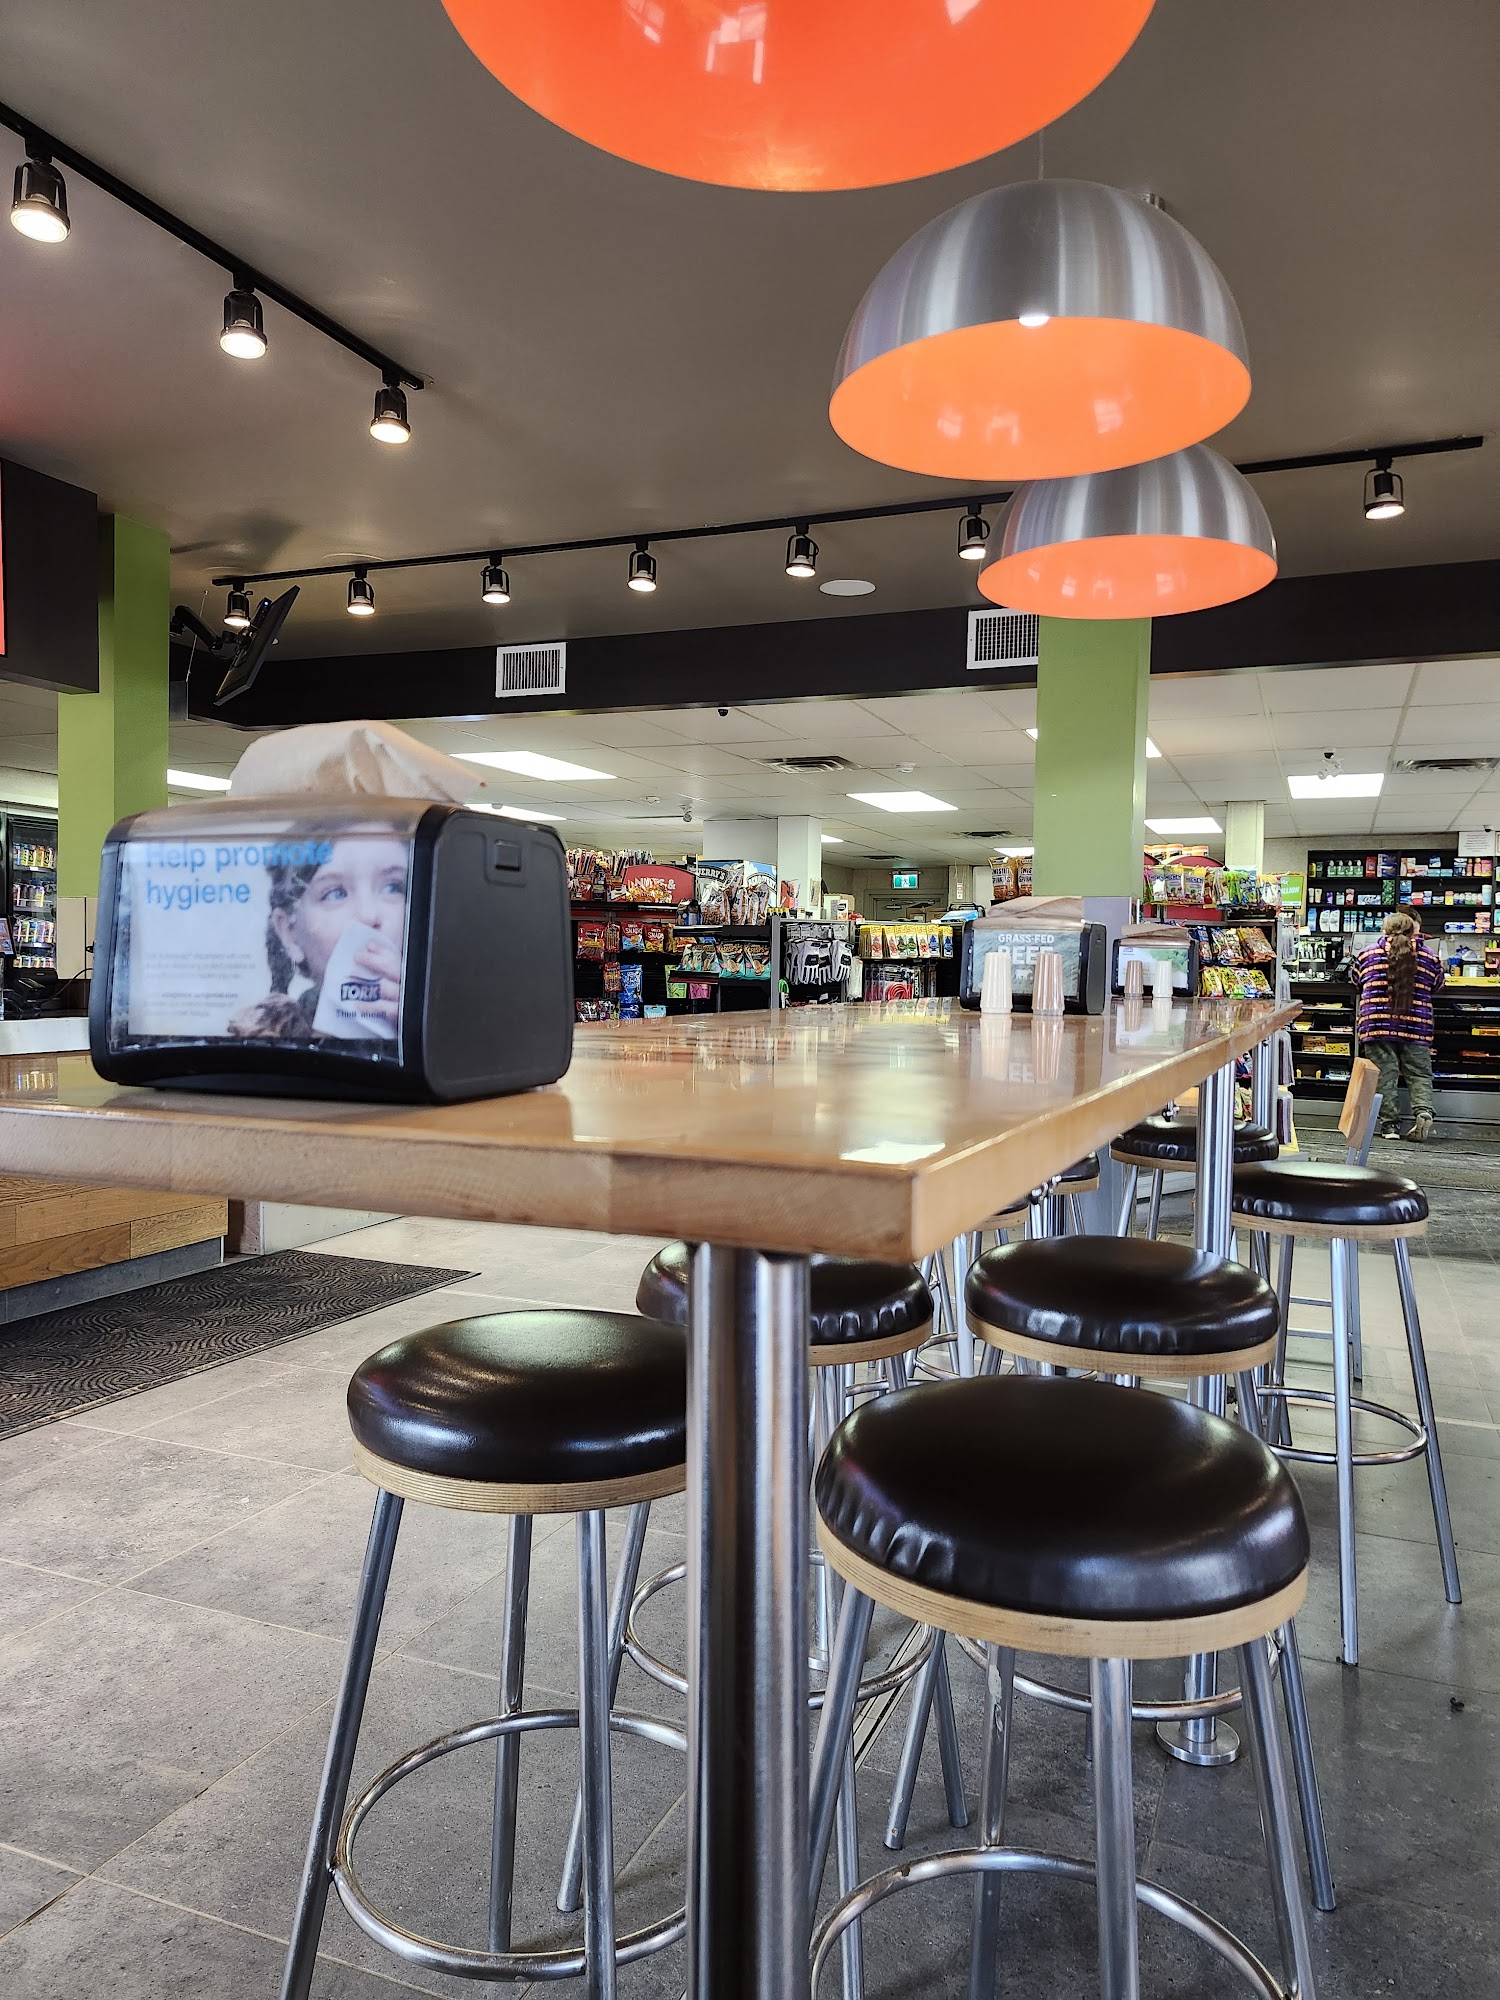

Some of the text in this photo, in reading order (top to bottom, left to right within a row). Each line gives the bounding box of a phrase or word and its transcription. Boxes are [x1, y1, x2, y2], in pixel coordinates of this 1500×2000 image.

[146, 840, 334, 873] Help promote
[146, 878, 252, 911] hygiene
[667, 878, 676, 890] &
[342, 984, 381, 1001] TORK
